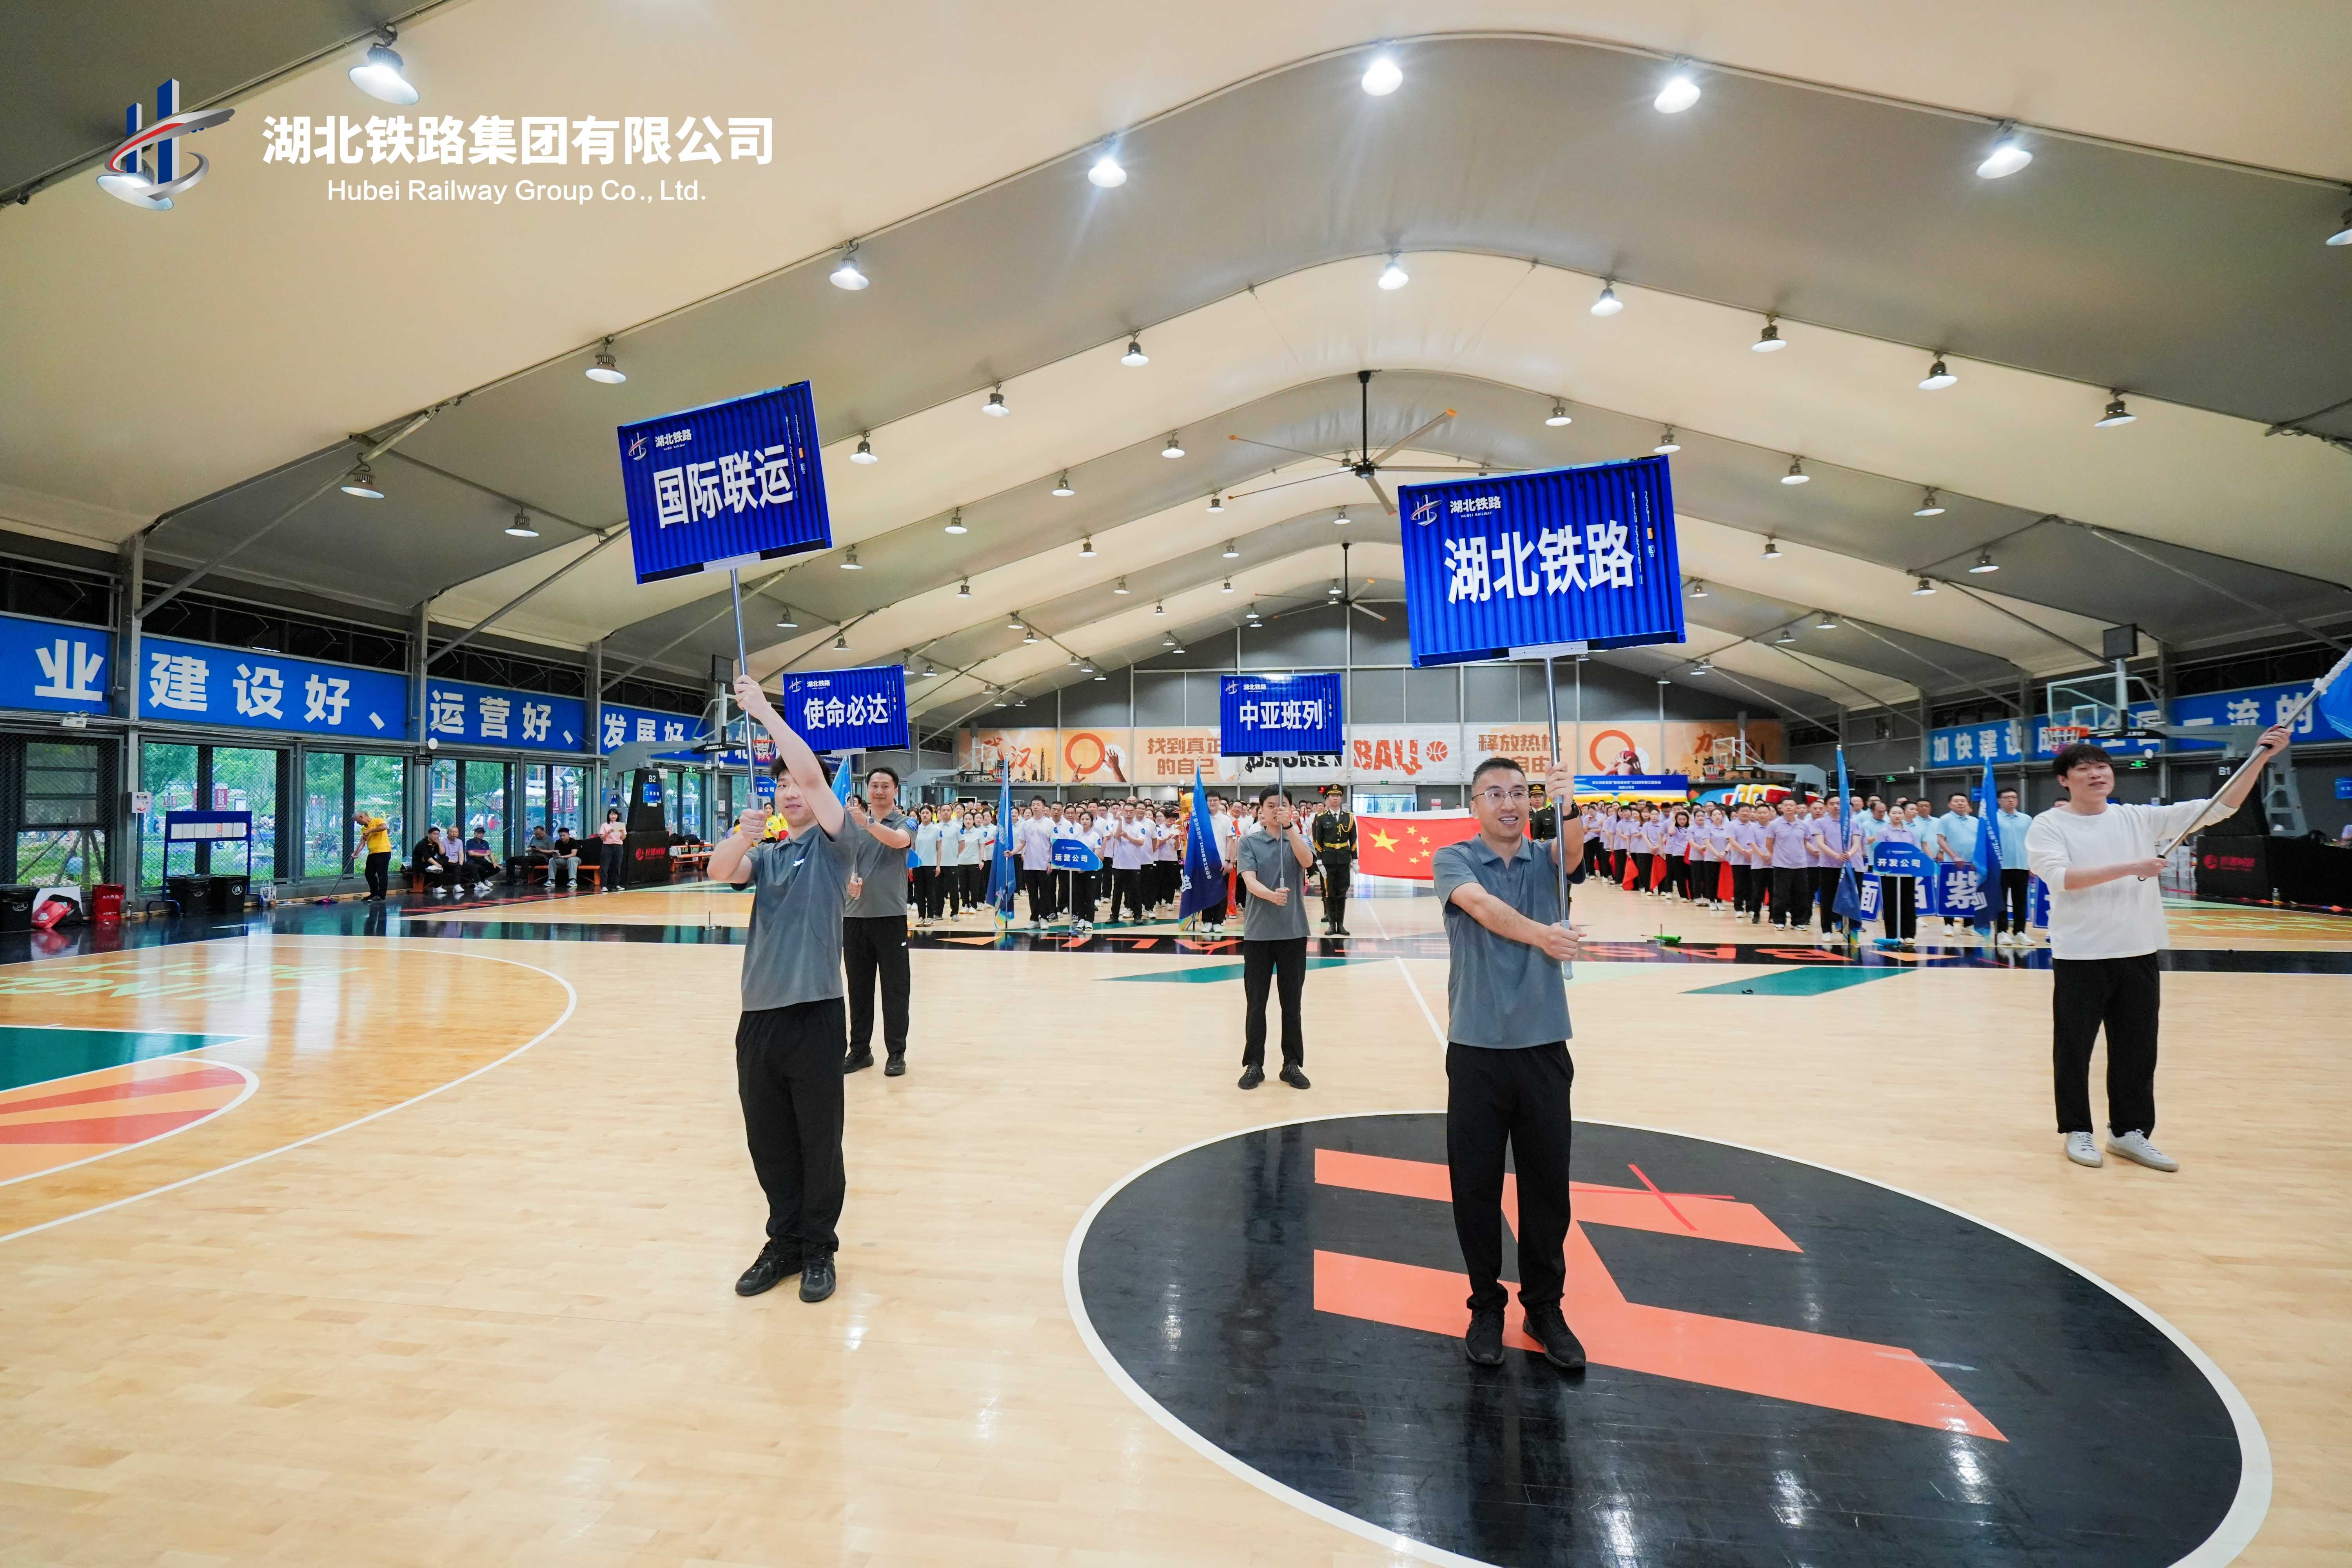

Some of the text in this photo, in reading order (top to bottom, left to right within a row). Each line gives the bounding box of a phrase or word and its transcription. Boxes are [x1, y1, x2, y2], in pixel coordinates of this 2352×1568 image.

[655, 429, 691, 447] 湖北铁路
[653, 445, 793, 529] 国际联运
[1450, 496, 1501, 514] 湖北铁路
[1445, 520, 1634, 604] 湖北铁路
[34, 639, 104, 701] 业
[149, 652, 385, 730] 建设好、
[803, 693, 889, 730] 使命必达
[1240, 699, 1323, 731] 中亚班列
[604, 713, 684, 753] 发展好
[1148, 737, 1221, 754] 找到真正
[1157, 759, 1214, 775] 的自己
[1354, 740, 1423, 775] BALL
[1495, 756, 1550, 773] 自由
[2218, 767, 2231, 775] B1
[1055, 853, 1088, 862] 运营公司
[1877, 858, 1920, 867] 开发公司
